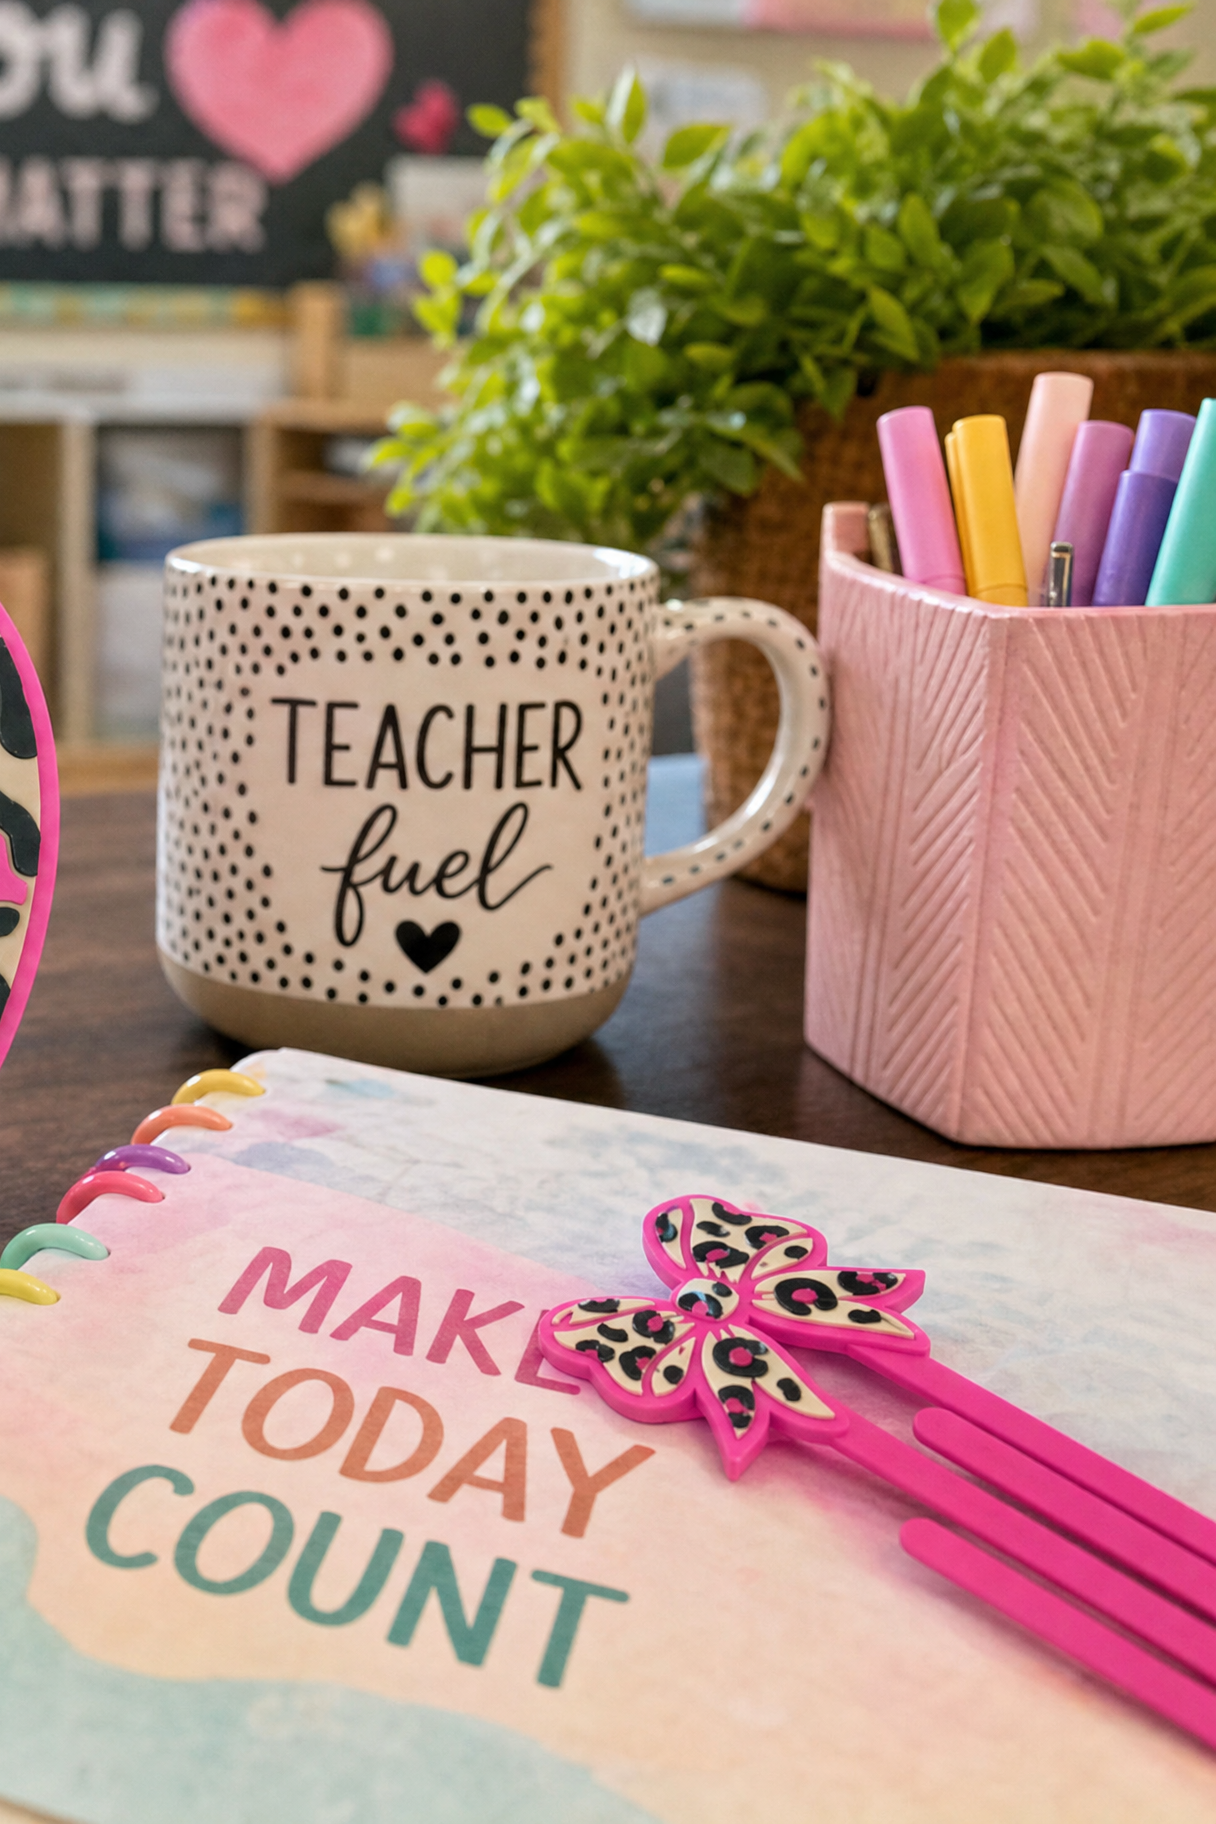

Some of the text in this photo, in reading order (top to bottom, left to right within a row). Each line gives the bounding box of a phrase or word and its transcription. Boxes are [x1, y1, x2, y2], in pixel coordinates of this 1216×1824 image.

[271, 698, 583, 790] TEACHER
[320, 802, 553, 947] fuel
[169, 1338, 656, 1538] TODAY
[85, 1465, 630, 1689] COUNT
